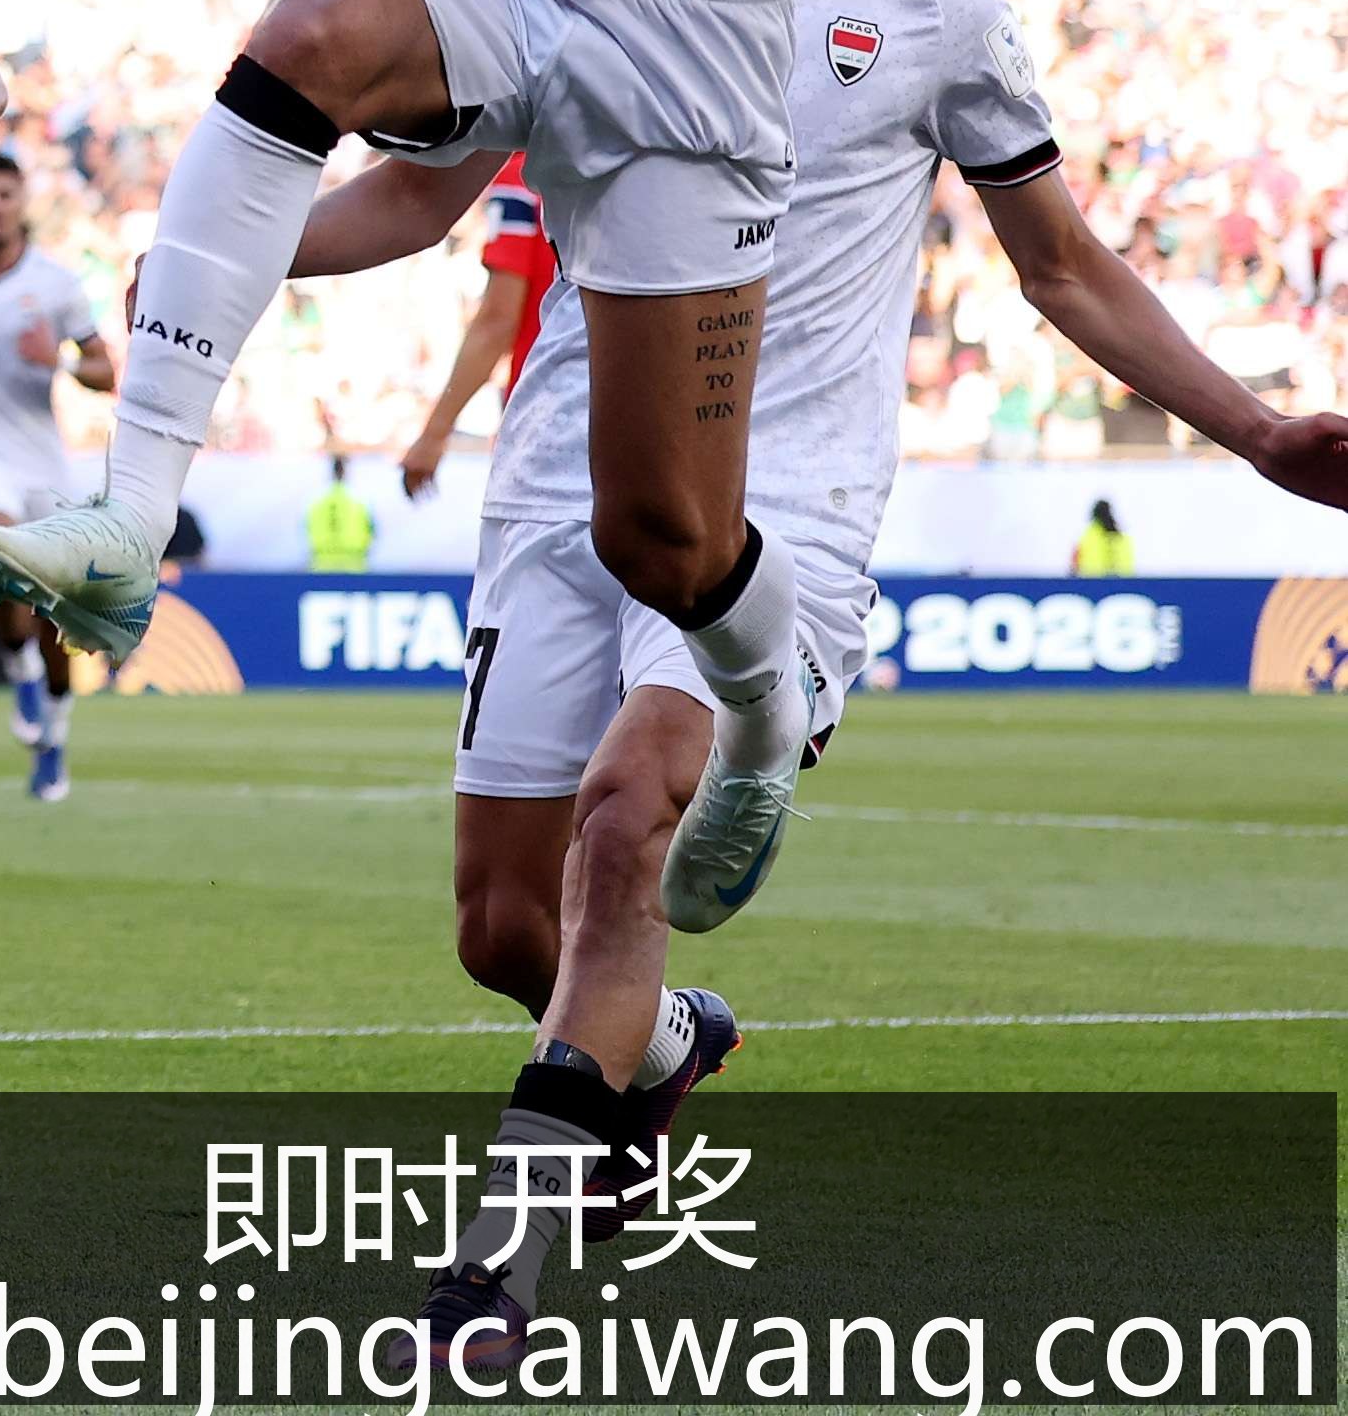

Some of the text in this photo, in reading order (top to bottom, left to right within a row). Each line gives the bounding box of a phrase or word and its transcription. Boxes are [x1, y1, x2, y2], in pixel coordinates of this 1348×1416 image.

[841, 21, 872, 34] IRAQ
[734, 217, 776, 250] JAKO
[697, 309, 754, 333] GAME
[135, 313, 214, 358] JAKO
[695, 340, 750, 362] PLAY
[706, 372, 734, 390] TO
[695, 401, 736, 423] WIN
[299, 590, 465, 672] FIFA
[905, 592, 1157, 673] 2026
[461, 627, 500, 750] 7
